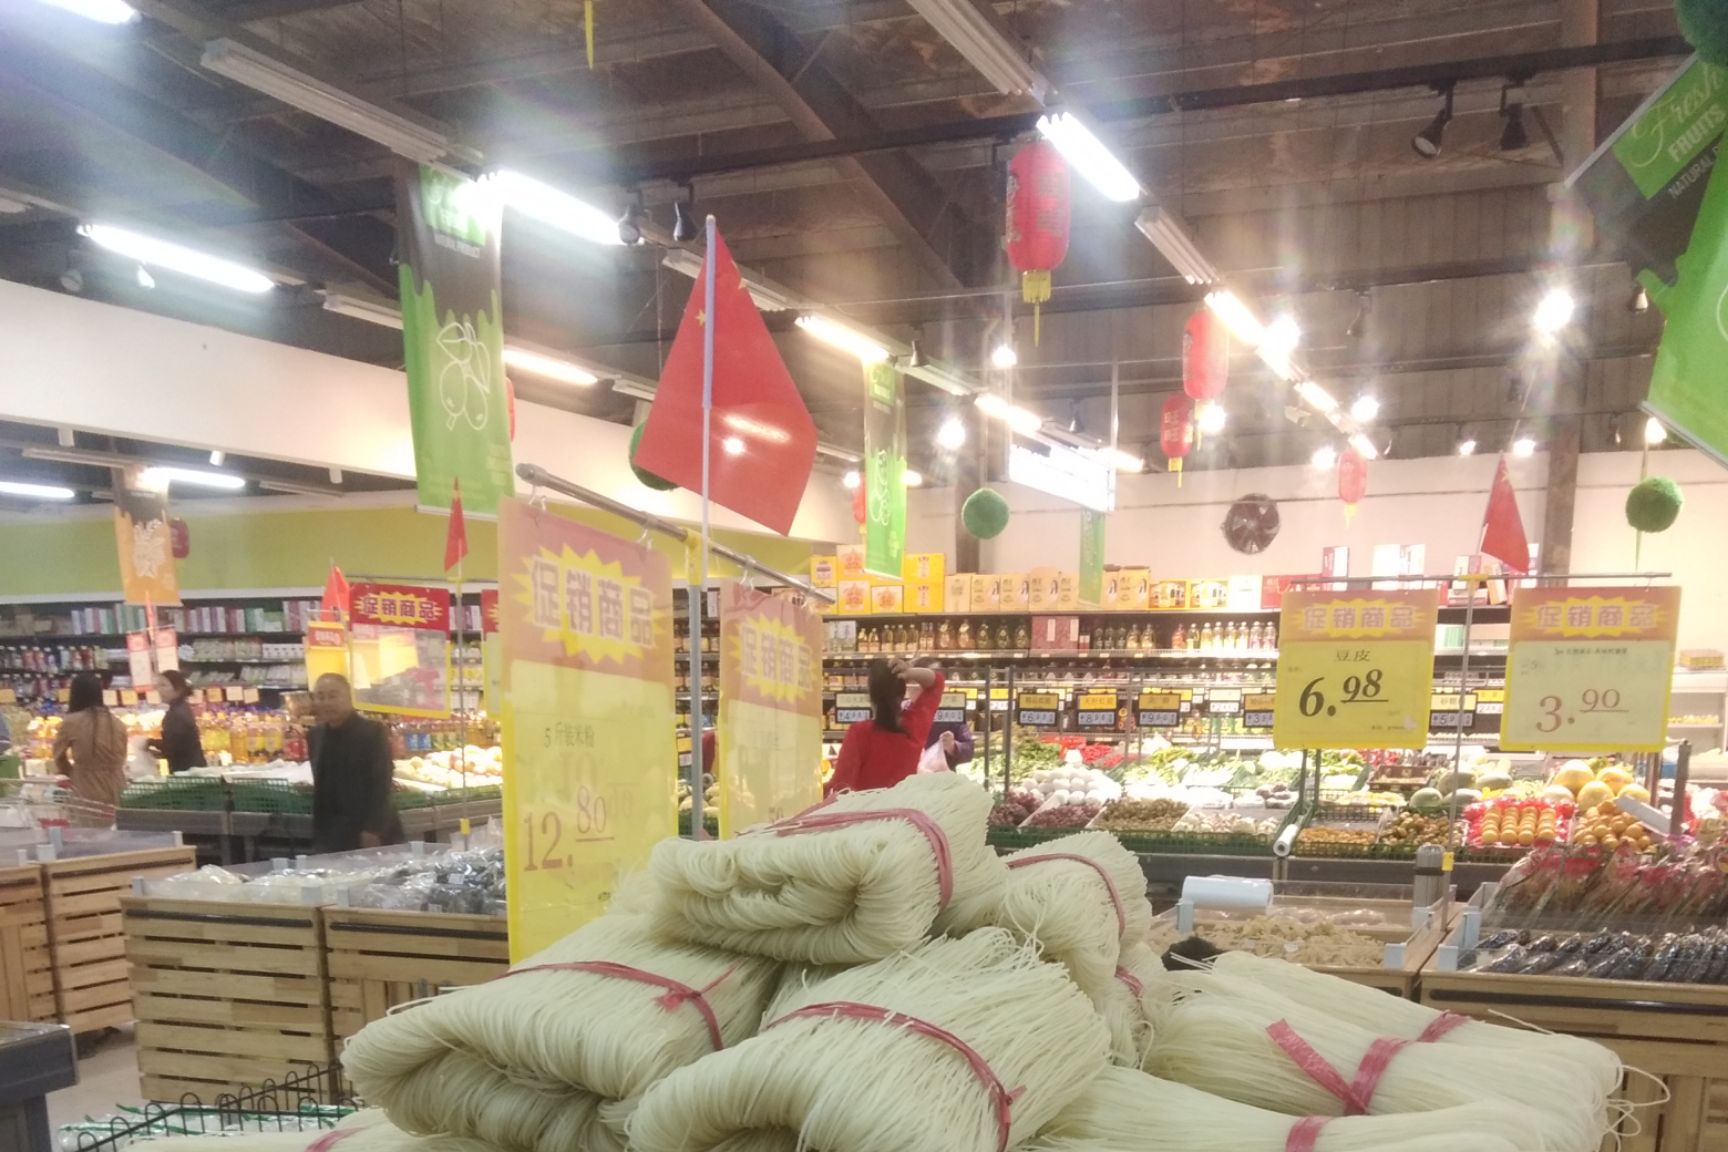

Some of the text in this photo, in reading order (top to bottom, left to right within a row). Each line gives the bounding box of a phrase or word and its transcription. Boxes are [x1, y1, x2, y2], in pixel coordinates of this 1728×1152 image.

[1668, 103, 1726, 162] FRUITS
[1668, 154, 1714, 199] NATURAL
[362, 595, 435, 621] 促销商品
[531, 554, 656, 649] 促销商品
[1304, 605, 1414, 629] 促销商品
[1538, 605, 1655, 628] 促销商品
[1336, 650, 1371, 662] 豆皮
